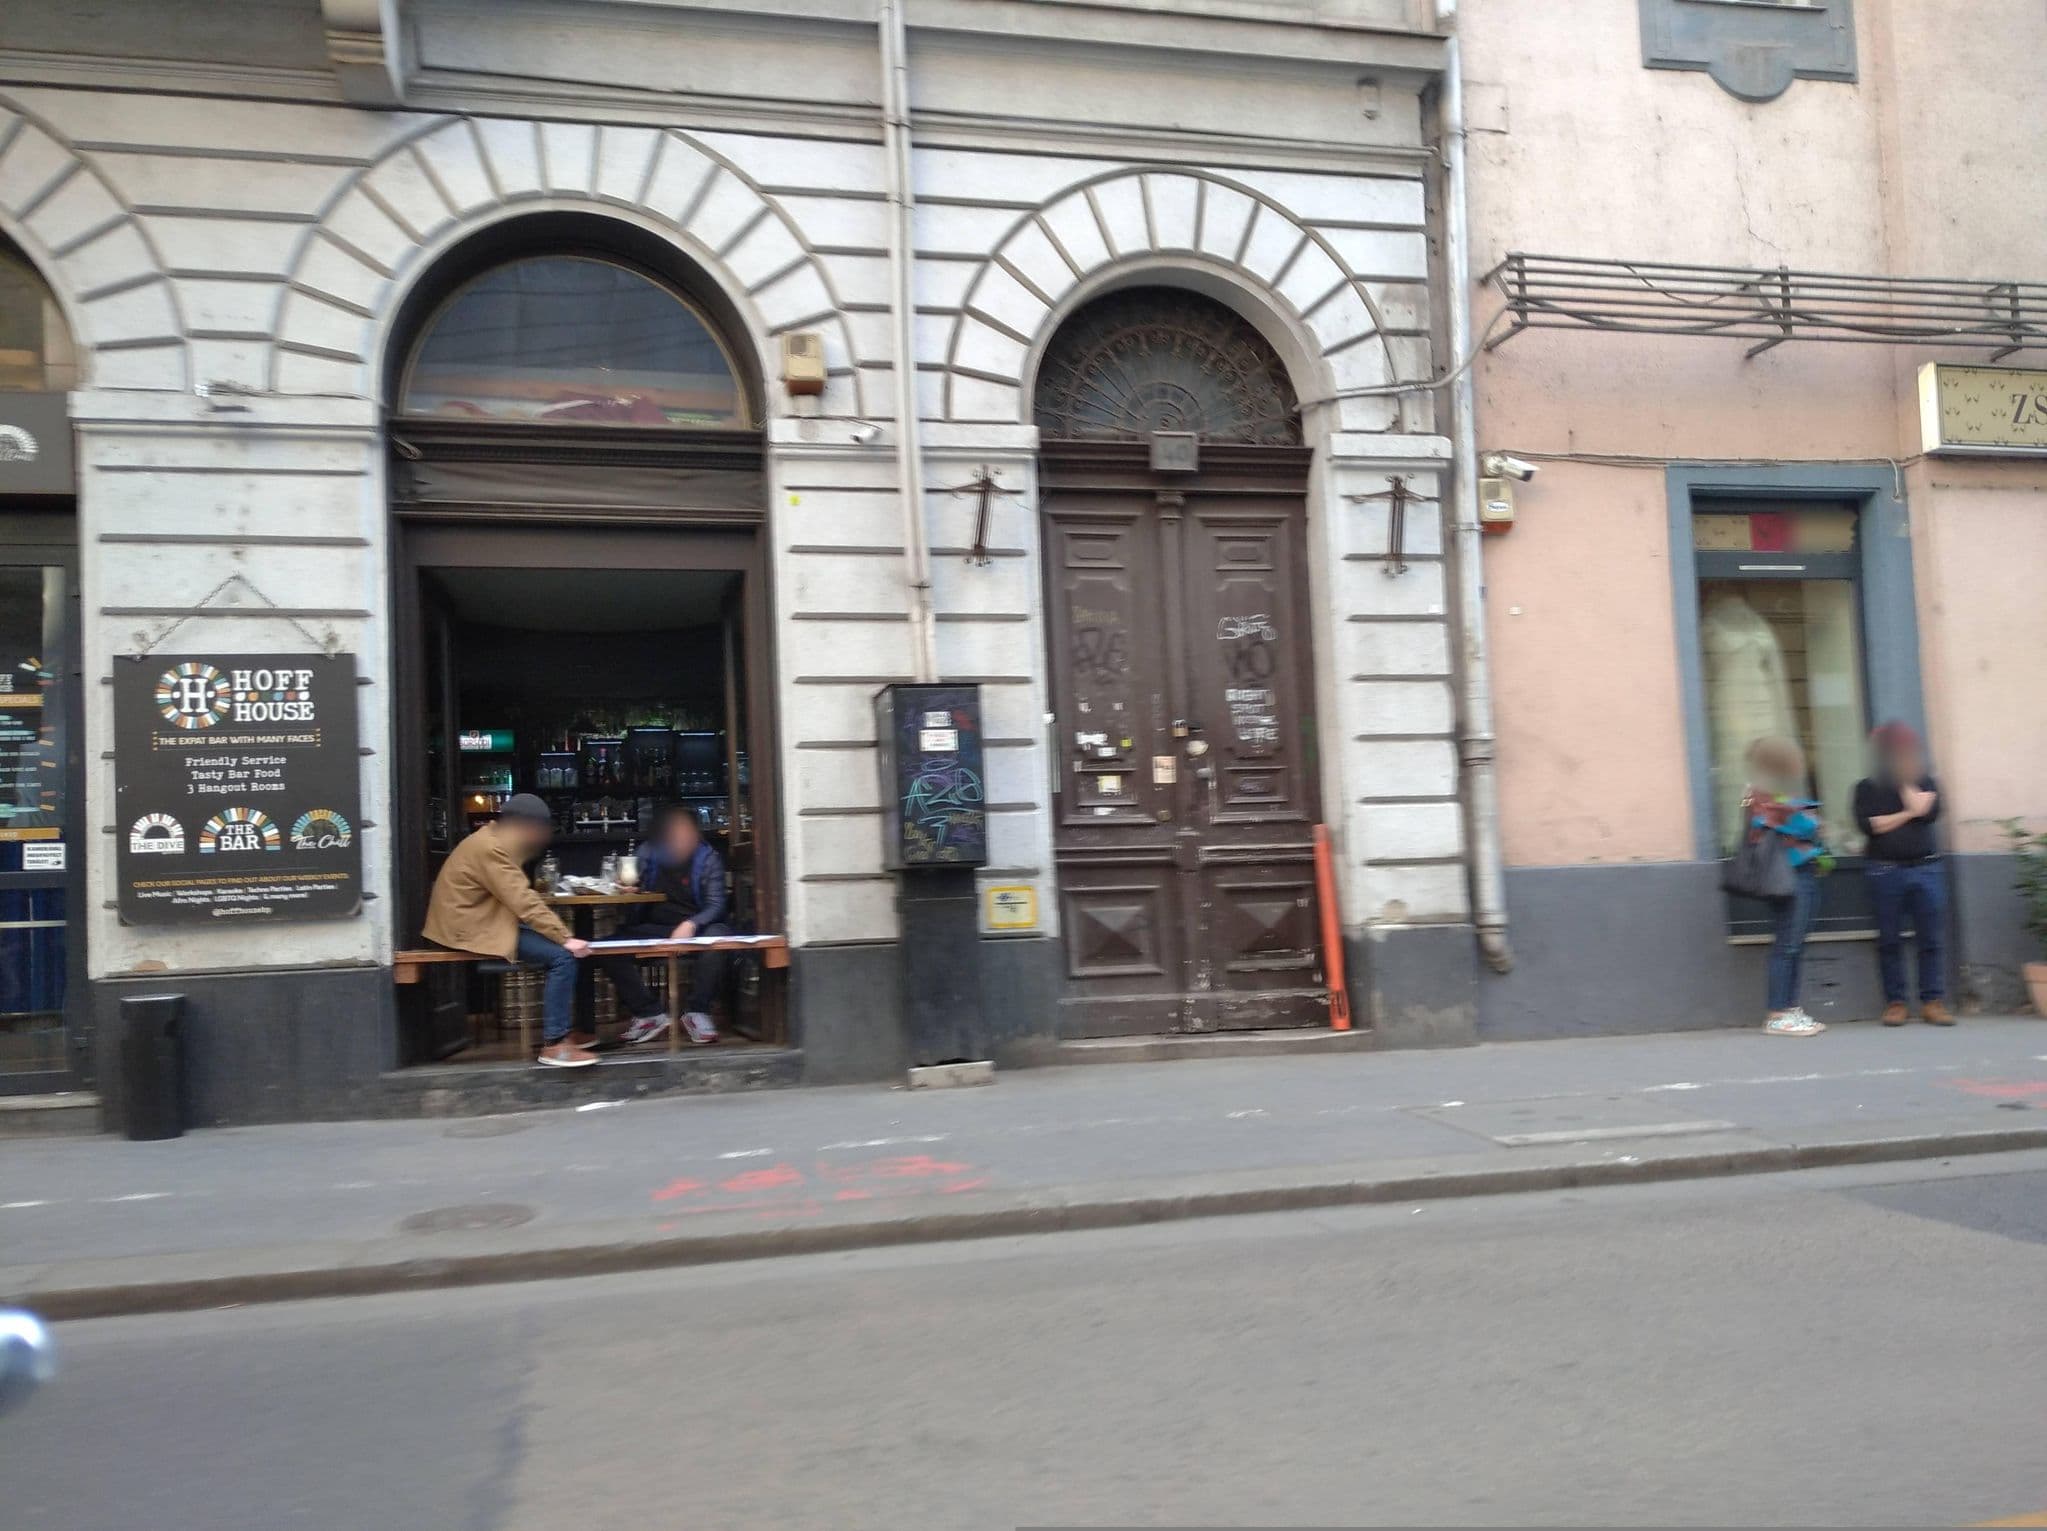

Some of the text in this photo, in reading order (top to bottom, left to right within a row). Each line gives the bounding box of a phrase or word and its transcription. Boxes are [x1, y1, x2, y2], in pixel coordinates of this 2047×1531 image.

[231, 669, 314, 691] HOFF
[234, 702, 315, 721] HOUSE
[158, 734, 315, 746] THE EXPAT BAR WITH MANY FACES
[184, 755, 287, 767] Friendly Service
[191, 769, 281, 780] Tasty Bar Food
[187, 782, 286, 794] 3 Hangout Rooms
[223, 824, 255, 835] THE
[132, 841, 184, 850] THE DIVE
[219, 835, 261, 851] BAR
[290, 834, 351, 849] The Chill
